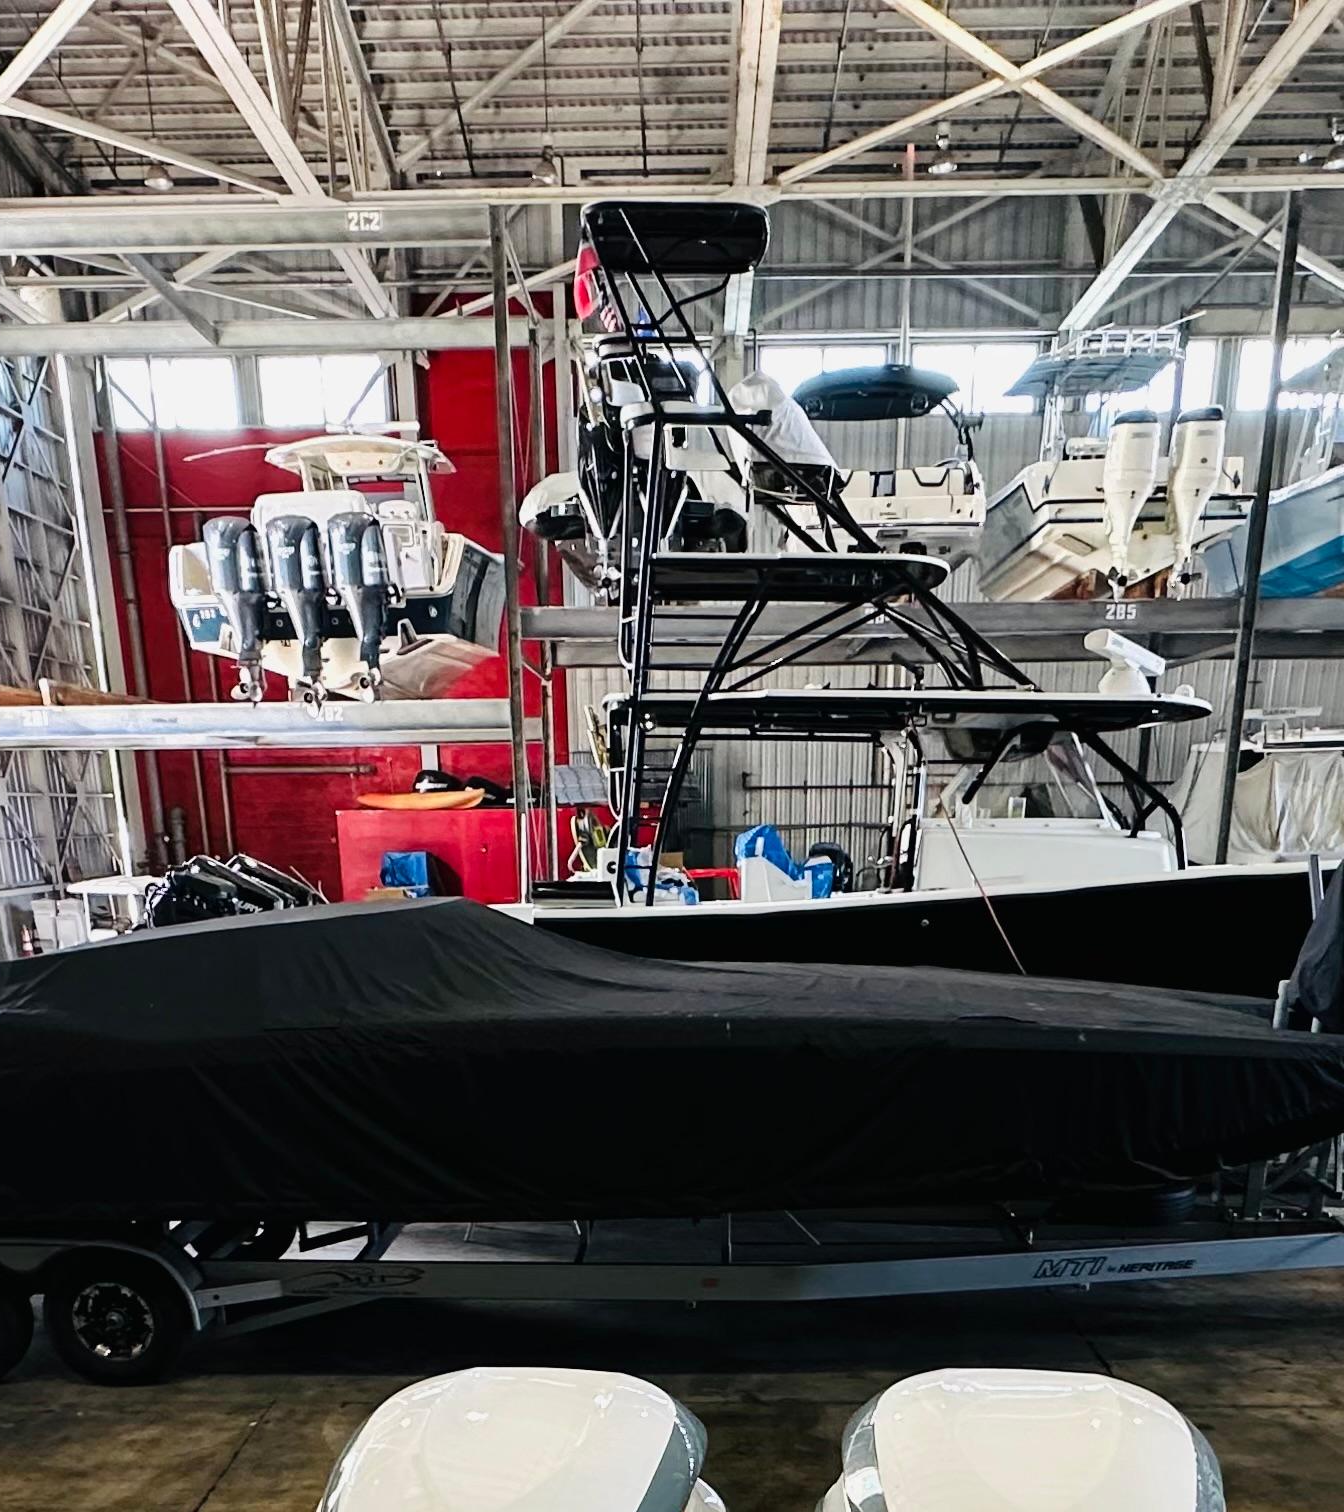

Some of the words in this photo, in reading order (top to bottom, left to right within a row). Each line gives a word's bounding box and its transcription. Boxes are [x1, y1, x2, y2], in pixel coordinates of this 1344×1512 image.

[347, 211, 380, 231] 2C2
[1106, 603, 1137, 620] 2B5
[1033, 1256, 1108, 1279] MTI
[1117, 1258, 1198, 1274] HERITAGE
